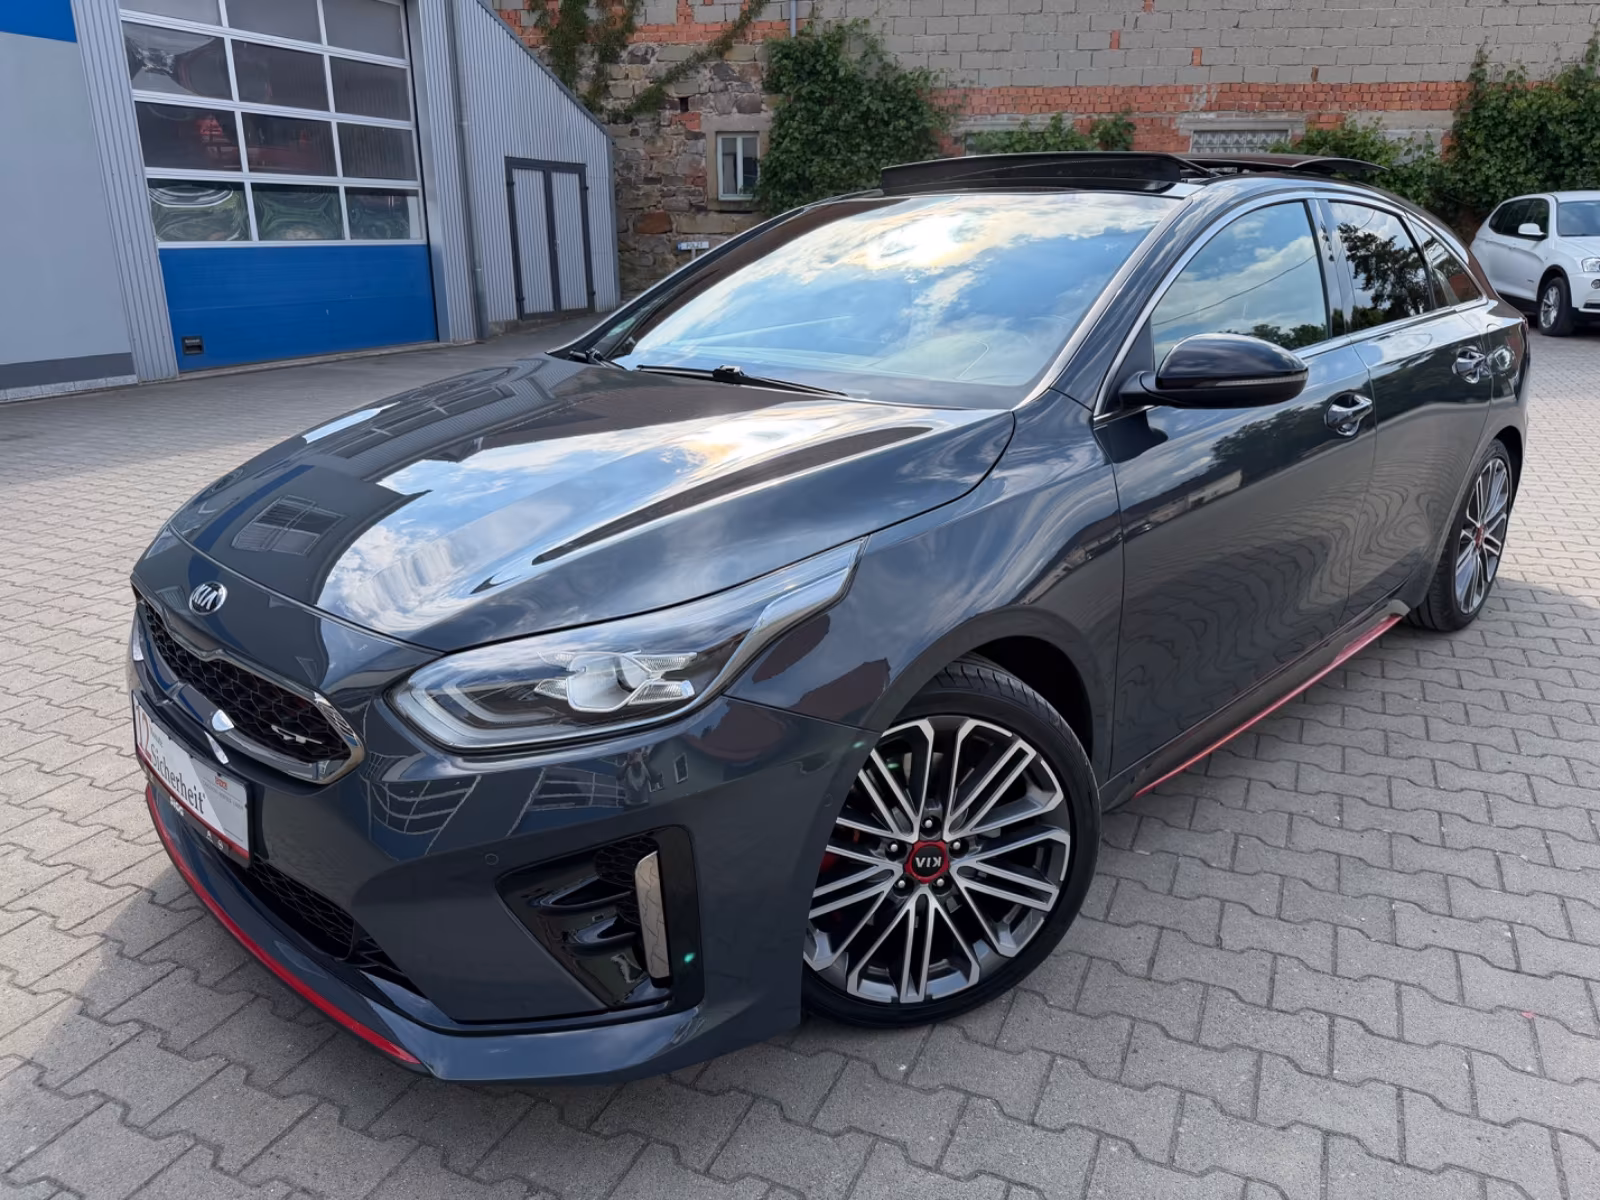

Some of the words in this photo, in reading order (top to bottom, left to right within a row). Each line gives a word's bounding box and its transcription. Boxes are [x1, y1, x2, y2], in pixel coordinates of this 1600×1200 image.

[192, 584, 218, 610] KIA
[150, 743, 205, 814] Sicherheit
[915, 856, 942, 868] KIA
